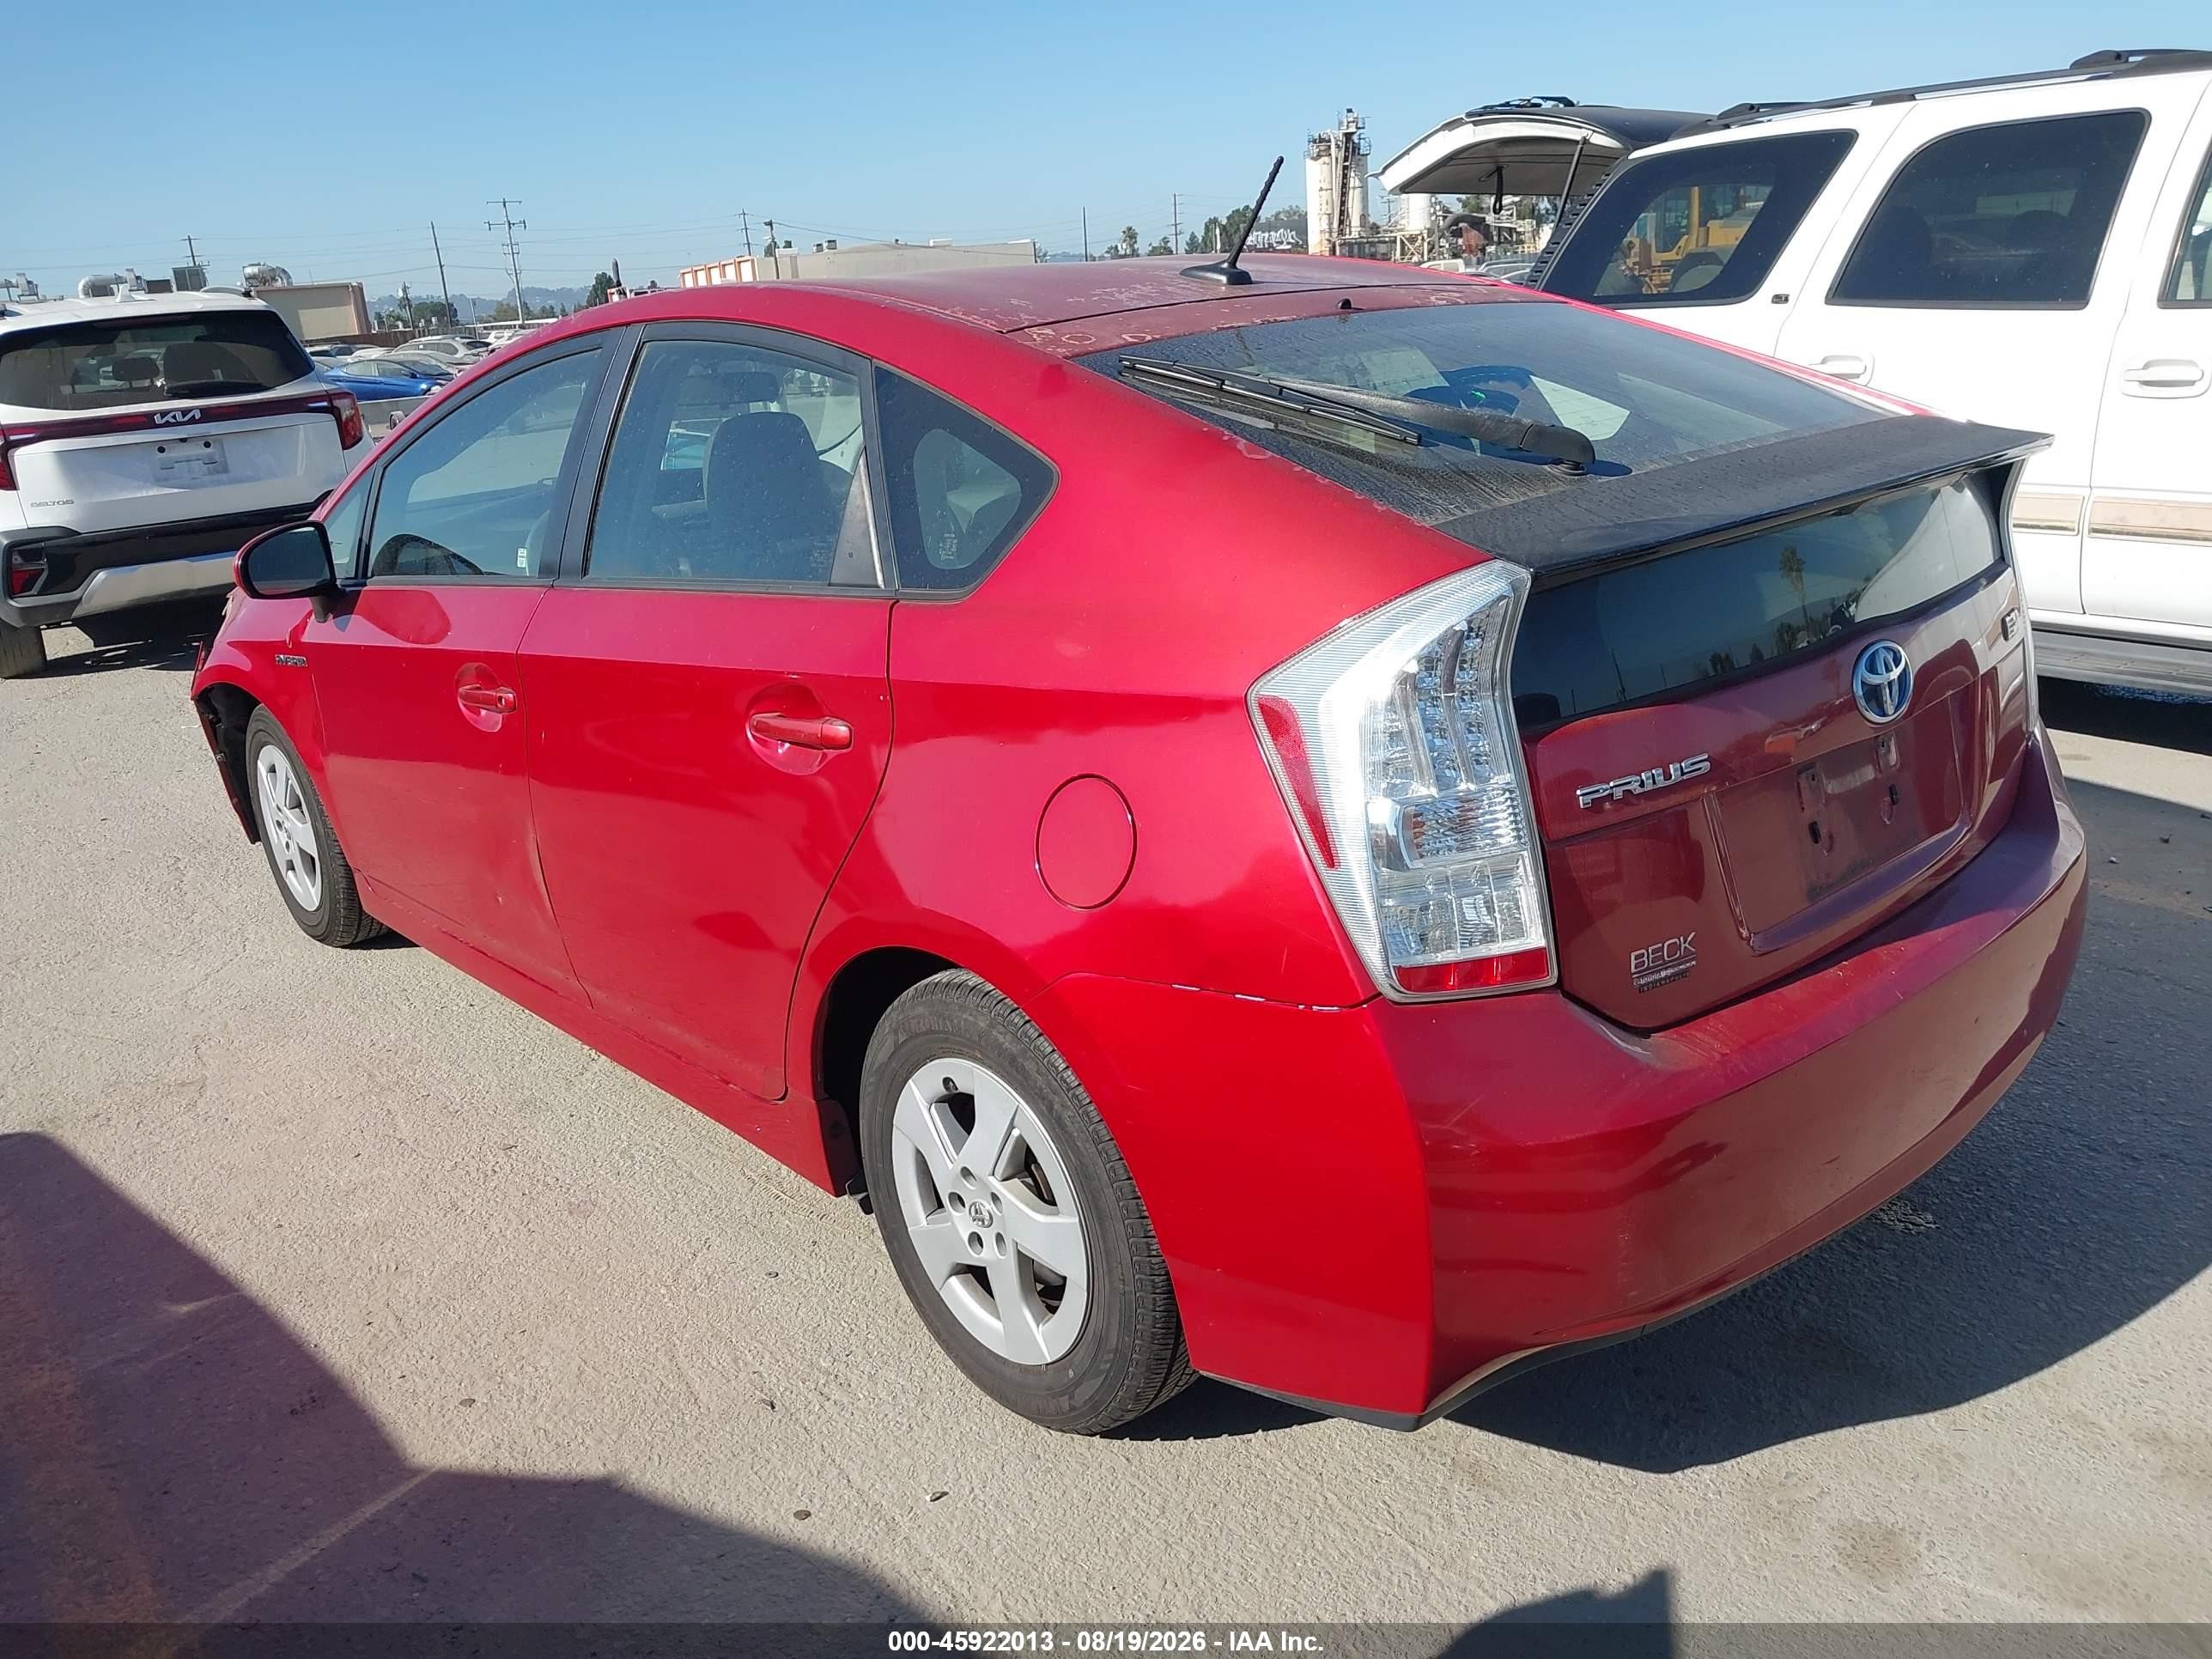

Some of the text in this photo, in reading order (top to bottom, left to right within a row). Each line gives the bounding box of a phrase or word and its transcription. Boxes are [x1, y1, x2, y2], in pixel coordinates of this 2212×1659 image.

[154, 409, 202, 424] KIA
[1576, 753, 1711, 809] PRIUS
[1630, 931, 1697, 974] BECK
